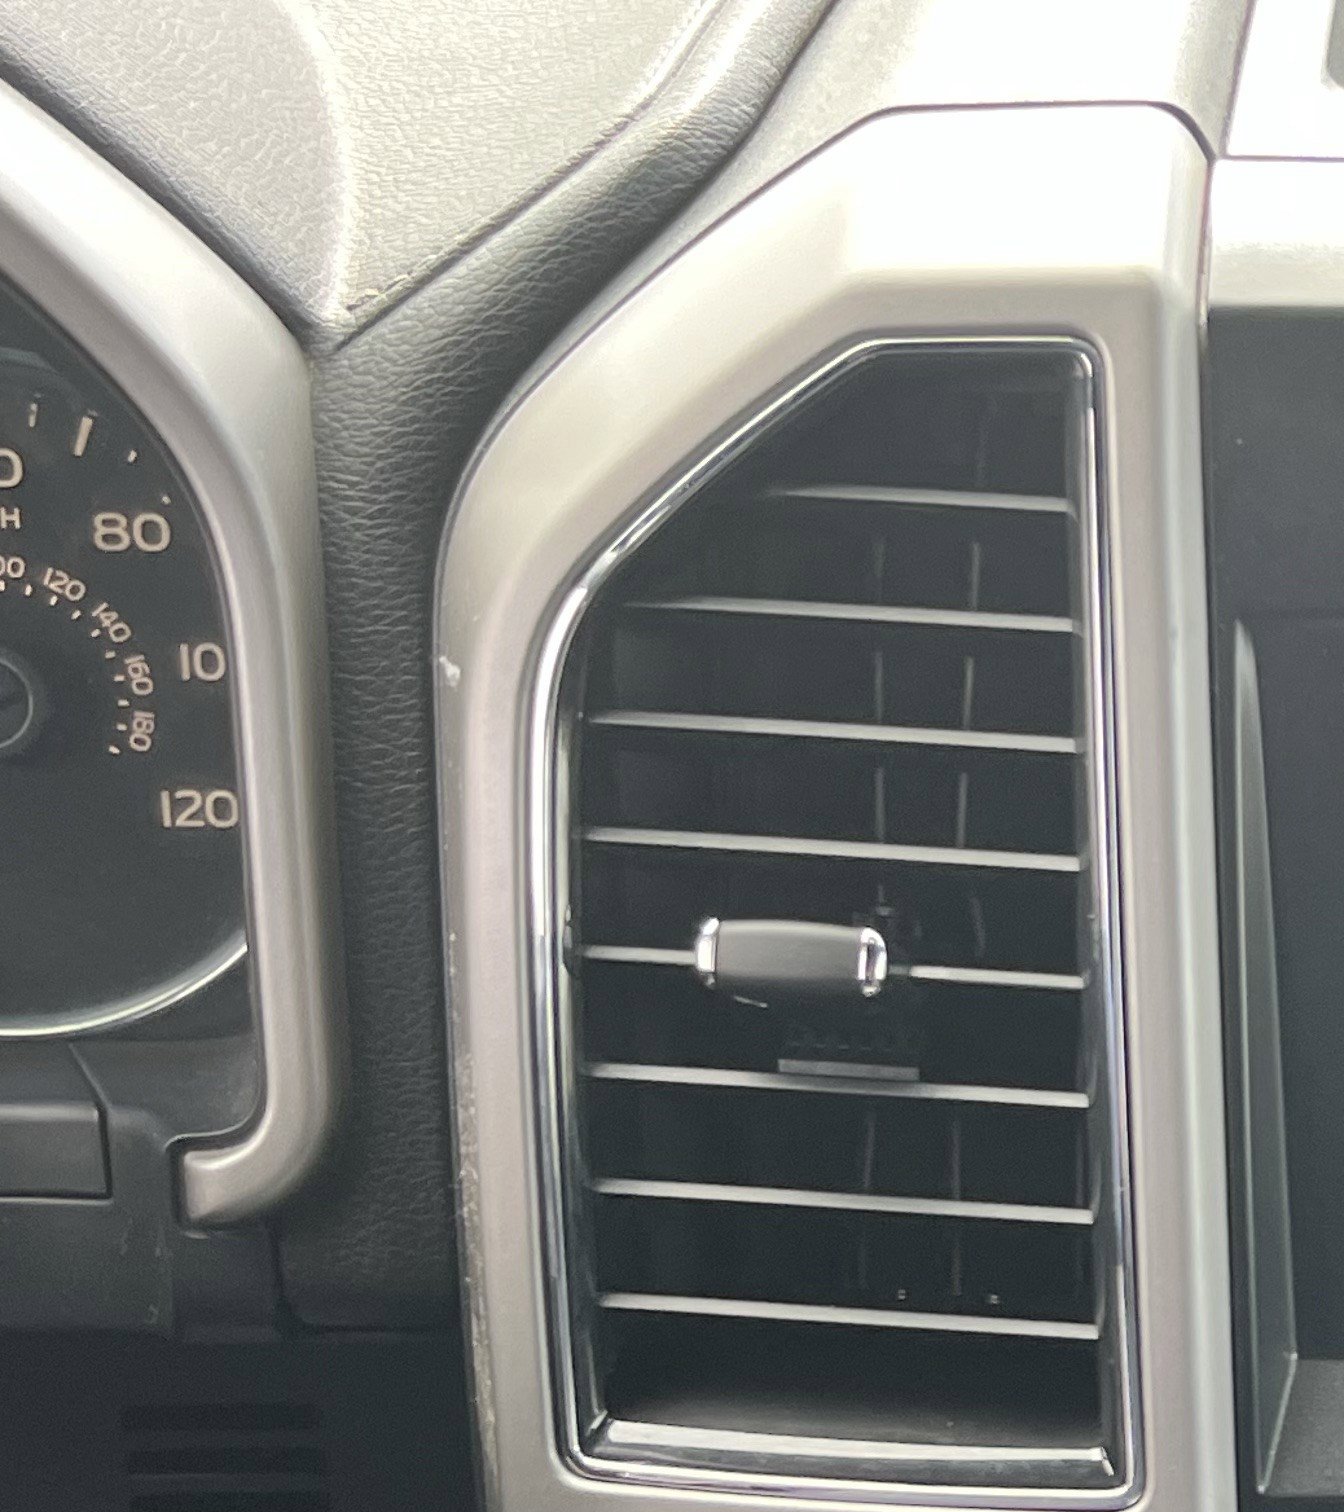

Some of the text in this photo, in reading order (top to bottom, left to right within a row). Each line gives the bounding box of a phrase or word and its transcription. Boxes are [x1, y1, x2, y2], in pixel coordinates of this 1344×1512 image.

[93, 511, 171, 553] 80
[43, 567, 87, 602] 120
[91, 602, 132, 643] 140
[124, 654, 154, 696] 160
[179, 641, 228, 683] 10
[128, 710, 155, 752] 180
[160, 788, 240, 830] 120
